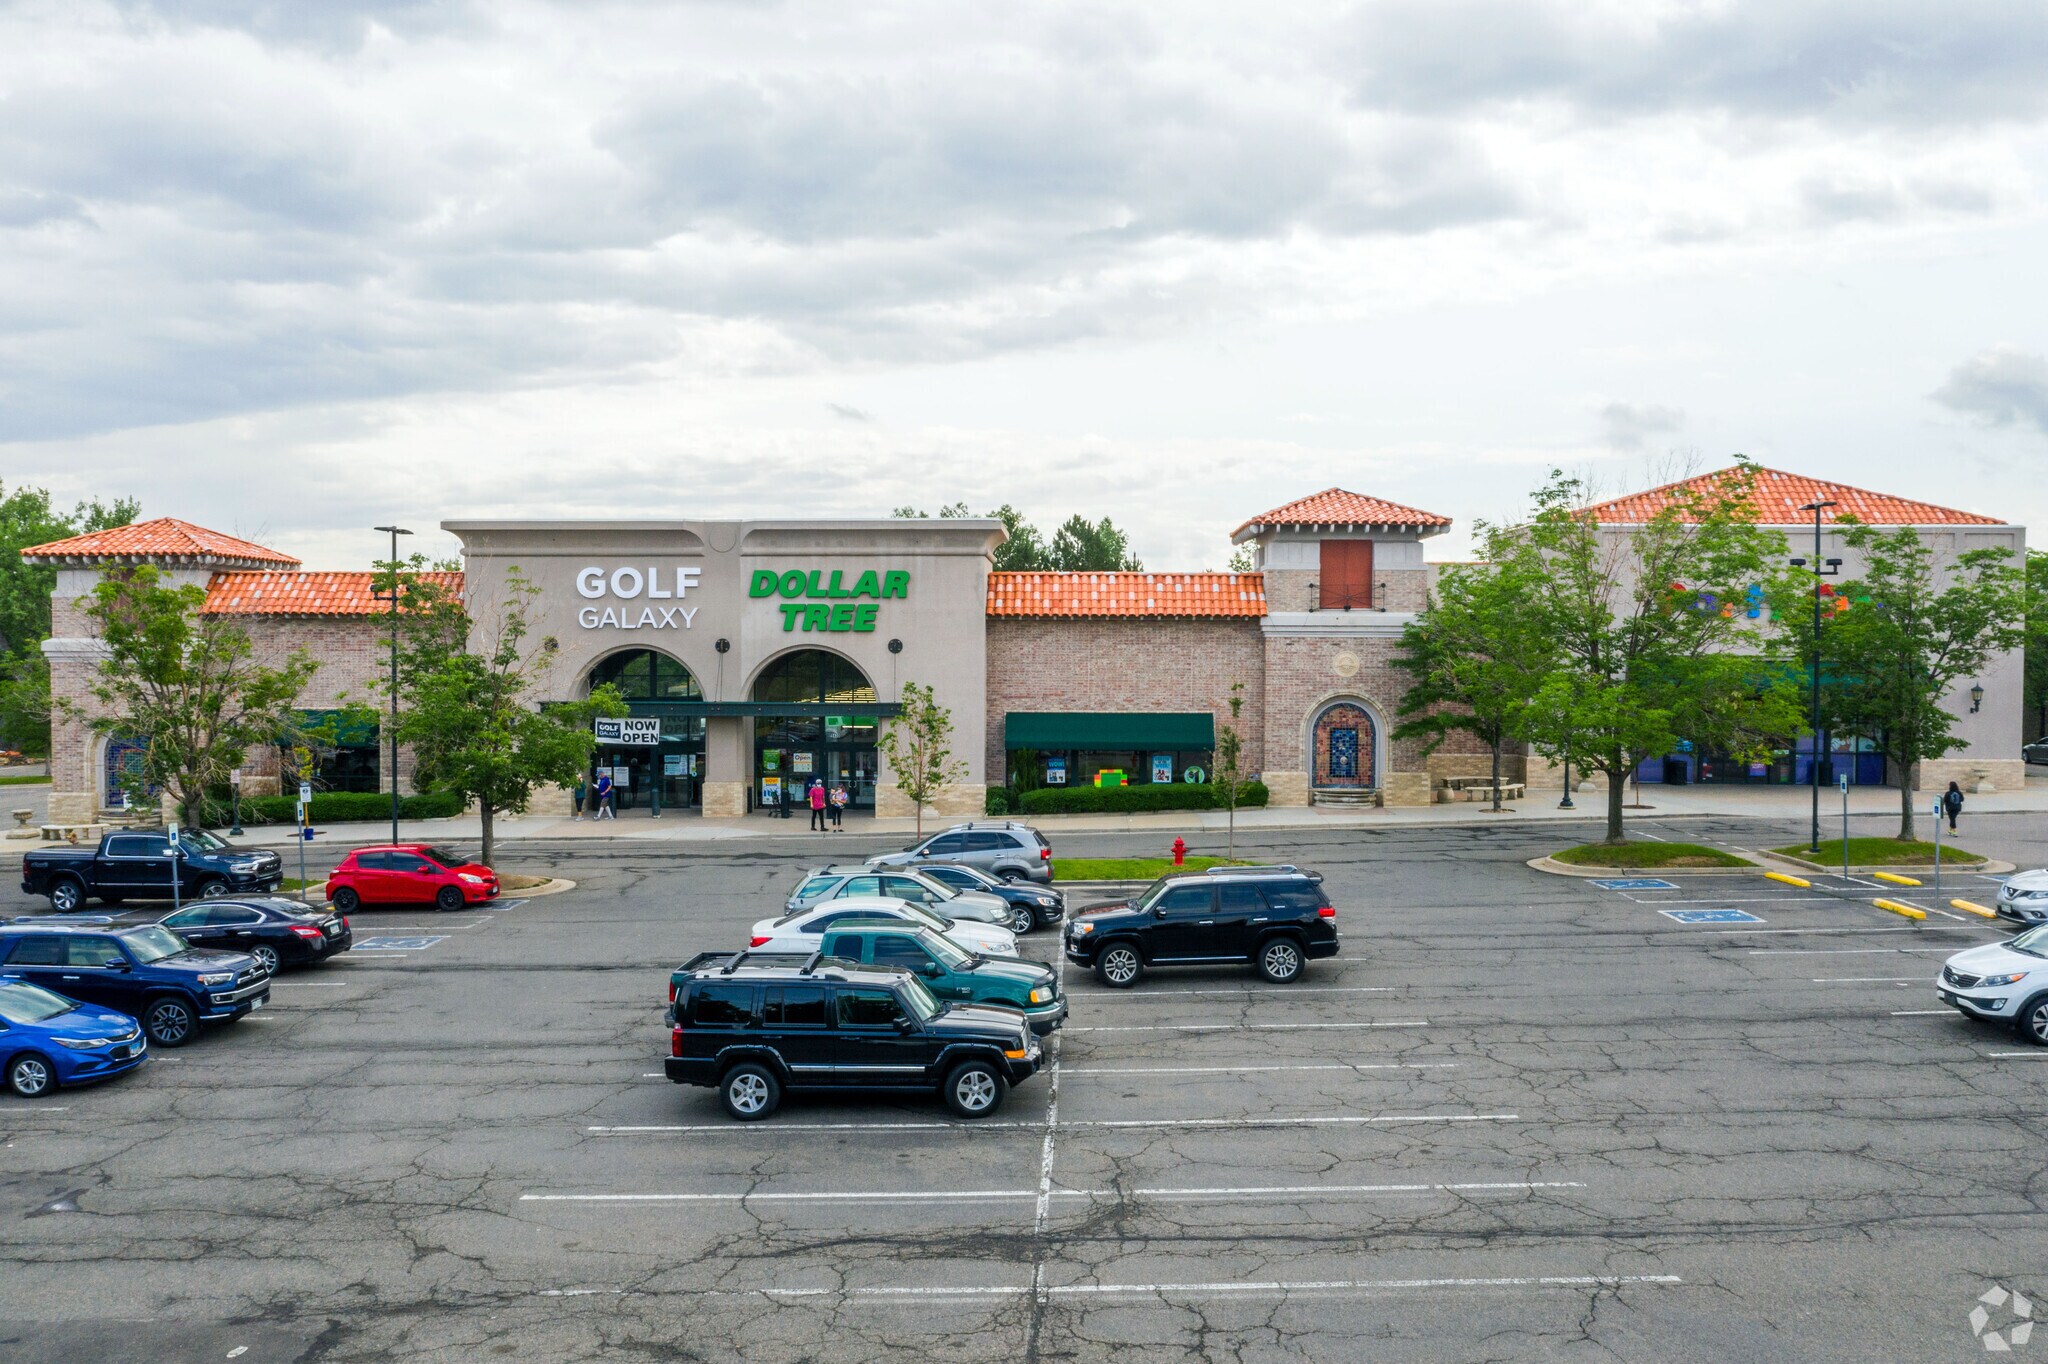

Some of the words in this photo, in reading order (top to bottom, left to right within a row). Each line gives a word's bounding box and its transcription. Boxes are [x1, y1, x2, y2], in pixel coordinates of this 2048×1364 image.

[576, 566, 701, 600] GOLF
[749, 569, 911, 599] DOLLAR
[578, 606, 699, 630] GALAXY
[779, 603, 880, 633] TREE
[598, 723, 619, 731] GOLF
[624, 720, 657, 731] NOW
[622, 733, 658, 743] OPEN
